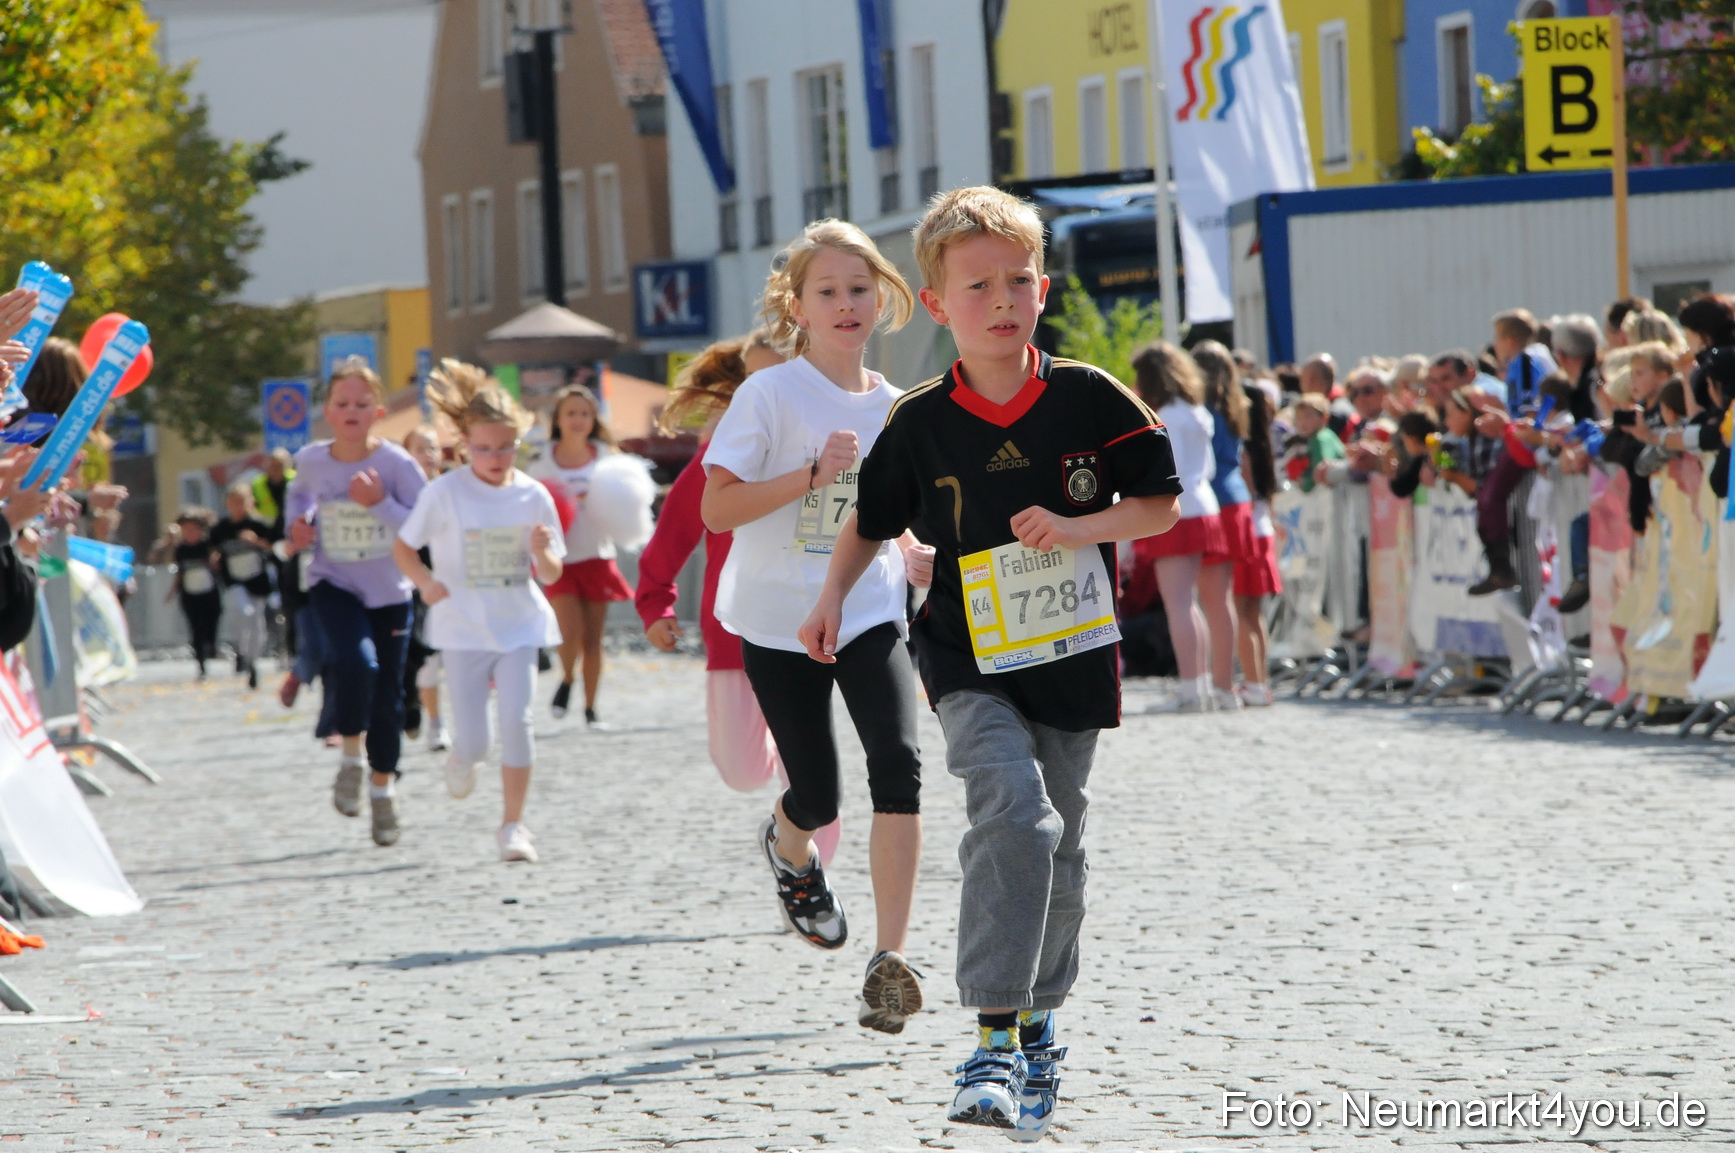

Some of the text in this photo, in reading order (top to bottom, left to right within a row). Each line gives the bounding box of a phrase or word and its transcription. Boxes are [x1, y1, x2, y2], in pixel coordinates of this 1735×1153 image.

[1088, 3, 1139, 58] HOTEL
[1535, 23, 1610, 52] Block
[1551, 65, 1598, 135] B
[986, 457, 1031, 473] adidas
[999, 549, 1063, 578] Fabian
[971, 597, 992, 616] K4
[1009, 572, 1100, 625] 7284
[1068, 623, 1116, 646] PFLEIDERER
[994, 651, 1033, 667] BOCK
[1033, 1053, 1052, 1061] FILA
